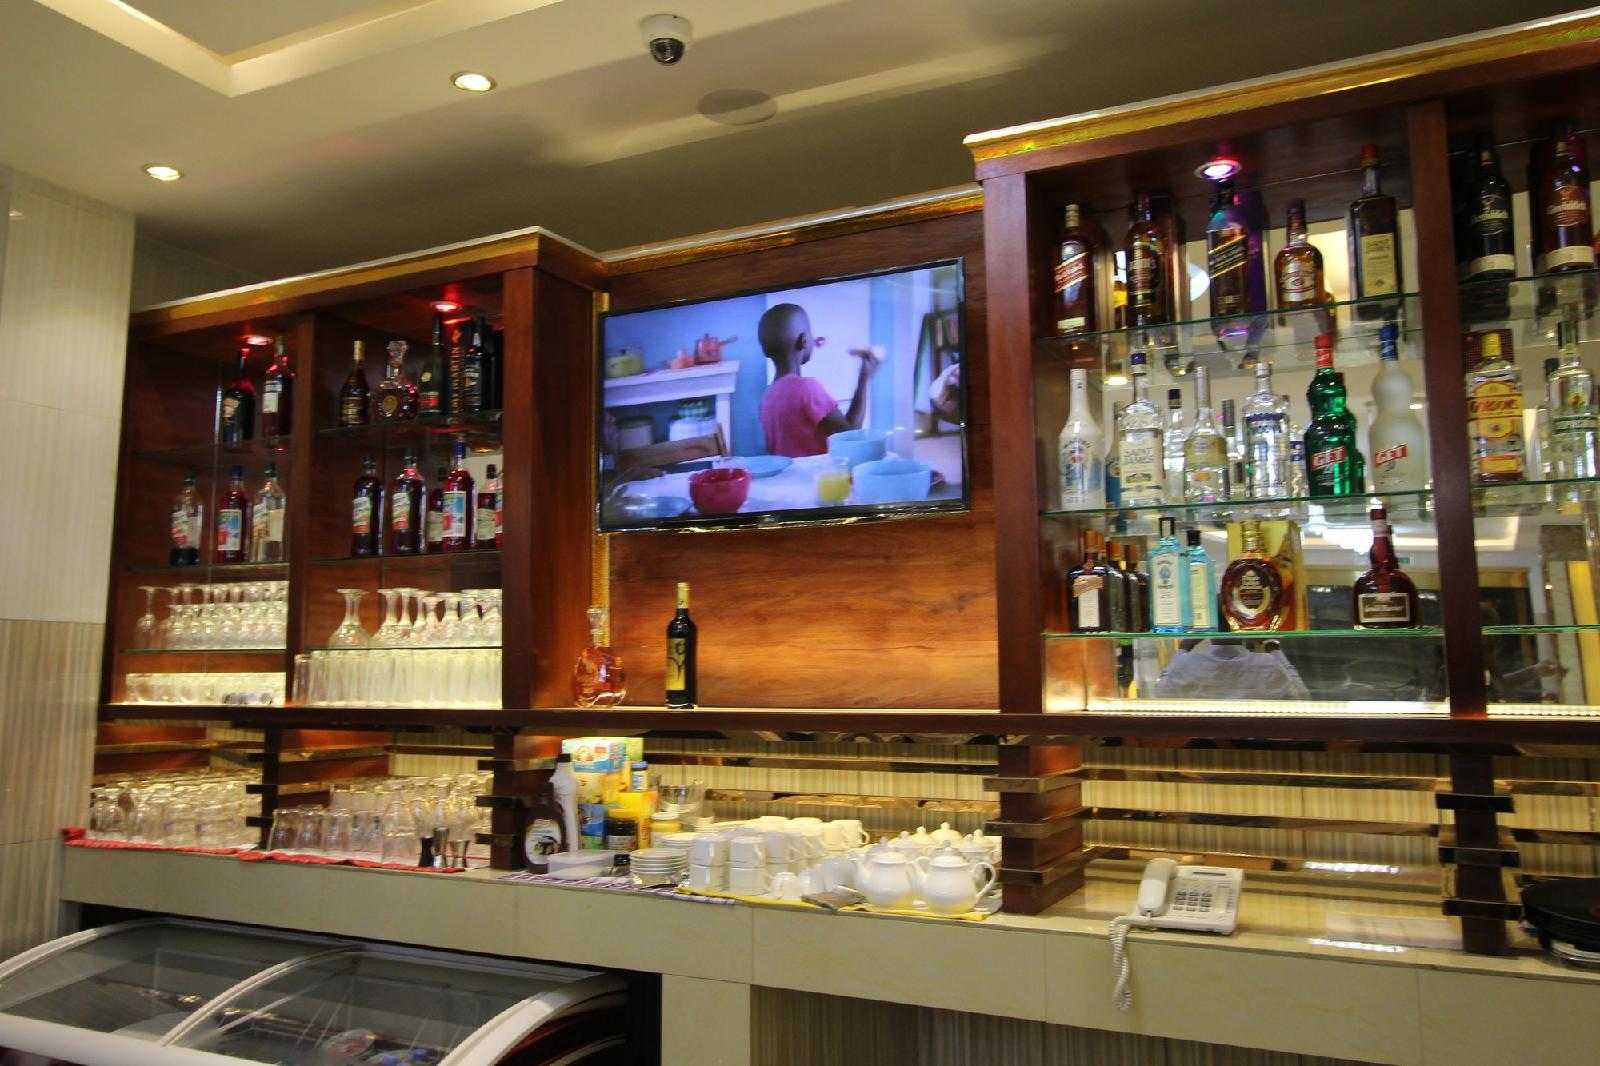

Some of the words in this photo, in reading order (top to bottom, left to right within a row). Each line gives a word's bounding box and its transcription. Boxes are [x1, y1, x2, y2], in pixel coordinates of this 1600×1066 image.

[1124, 447, 1153, 456] SAINT
[1313, 448, 1344, 467] GET
[1376, 446, 1403, 464] GET
